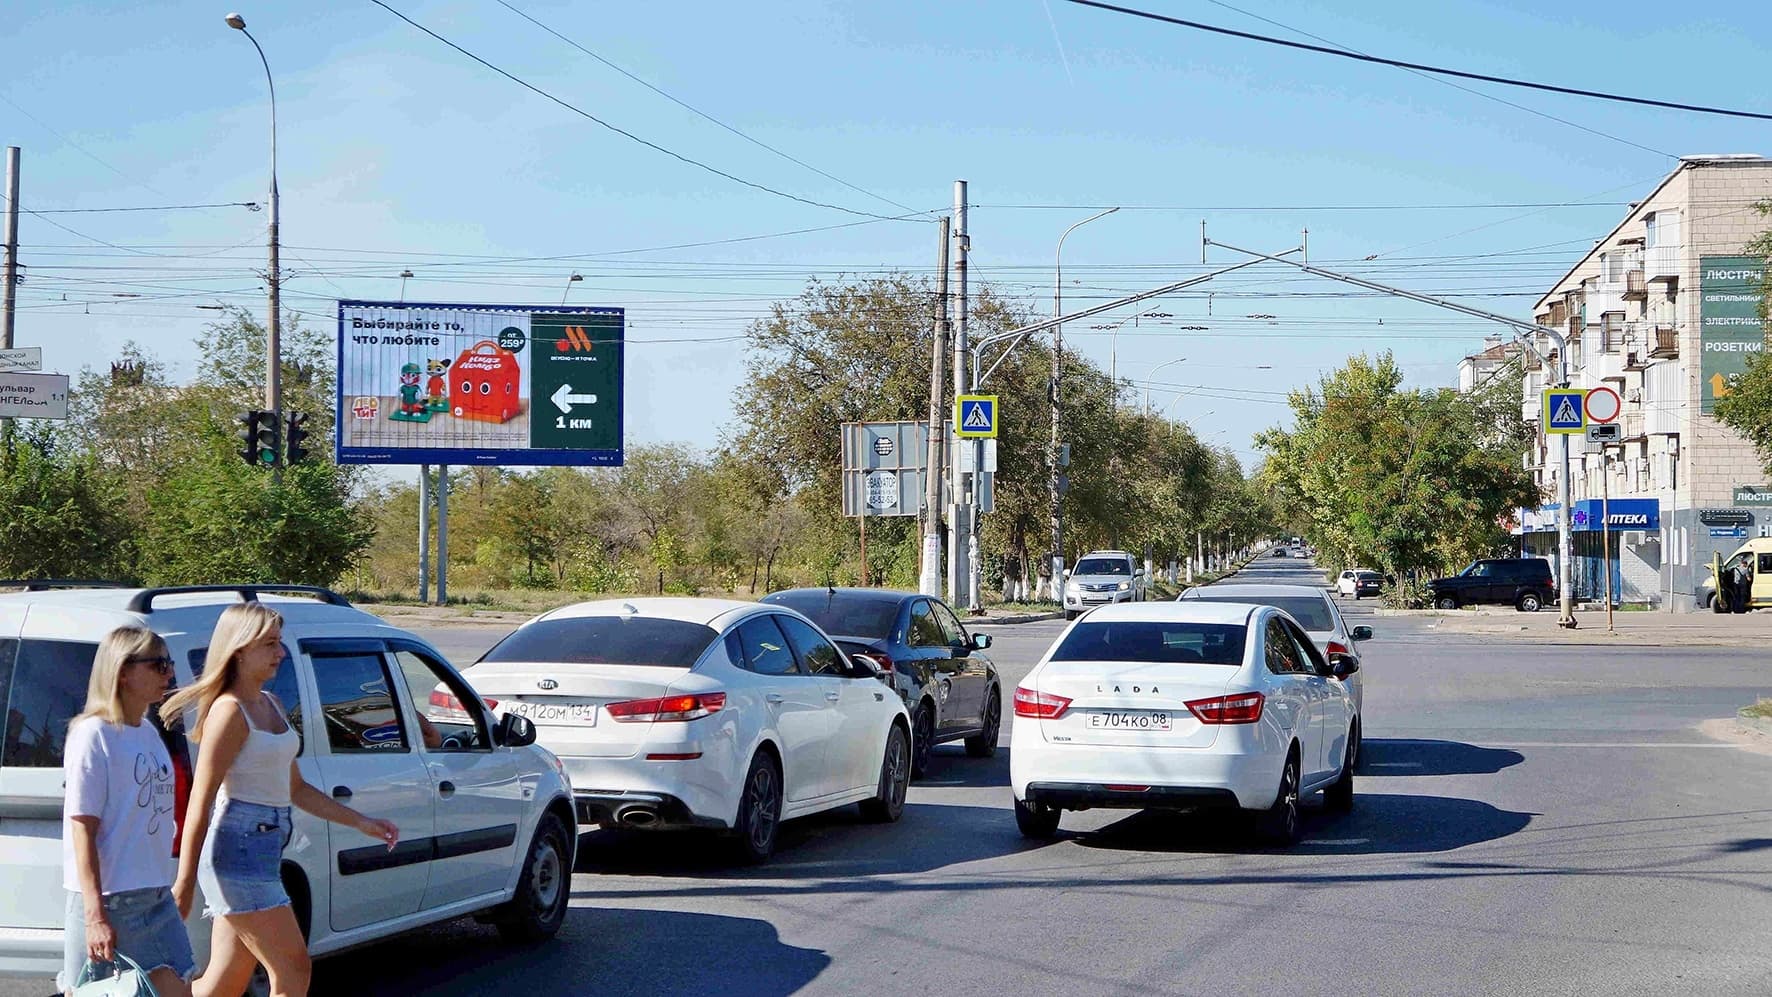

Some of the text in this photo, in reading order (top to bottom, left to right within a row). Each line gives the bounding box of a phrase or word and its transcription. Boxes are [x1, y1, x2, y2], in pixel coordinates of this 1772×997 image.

[352, 317, 465, 333] Выбирайте то,
[1705, 317, 1761, 326] ЭЛЕКТРИКА
[352, 334, 440, 346] что любите
[1705, 342, 1762, 352] РОЗЕТКИ
[556, 415, 566, 428] 1
[540, 682, 555, 690] KIA
[1097, 685, 1159, 693] LADA
